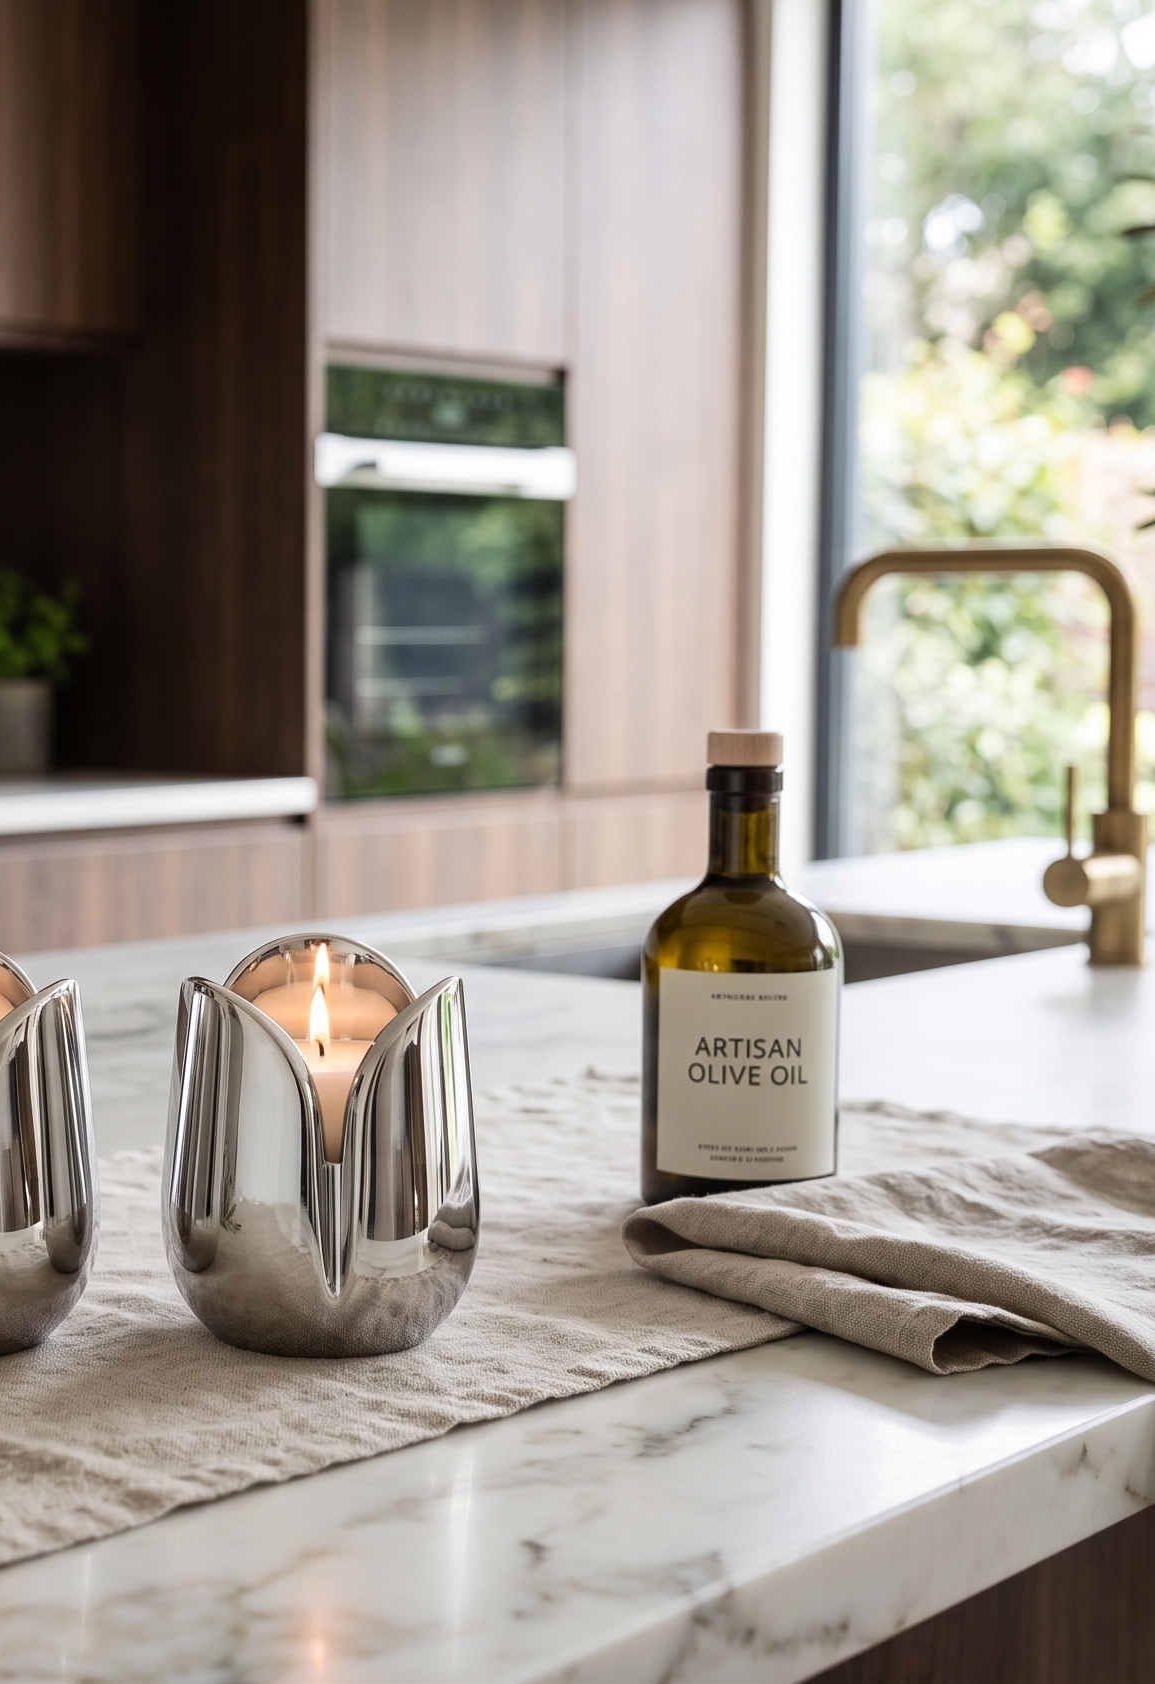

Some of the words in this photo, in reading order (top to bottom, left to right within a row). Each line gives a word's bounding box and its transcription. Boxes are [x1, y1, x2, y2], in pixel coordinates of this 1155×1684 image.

[694, 1036, 802, 1060] ARTISAN
[687, 1062, 762, 1086] OLIVE
[769, 1064, 808, 1086] OIL
